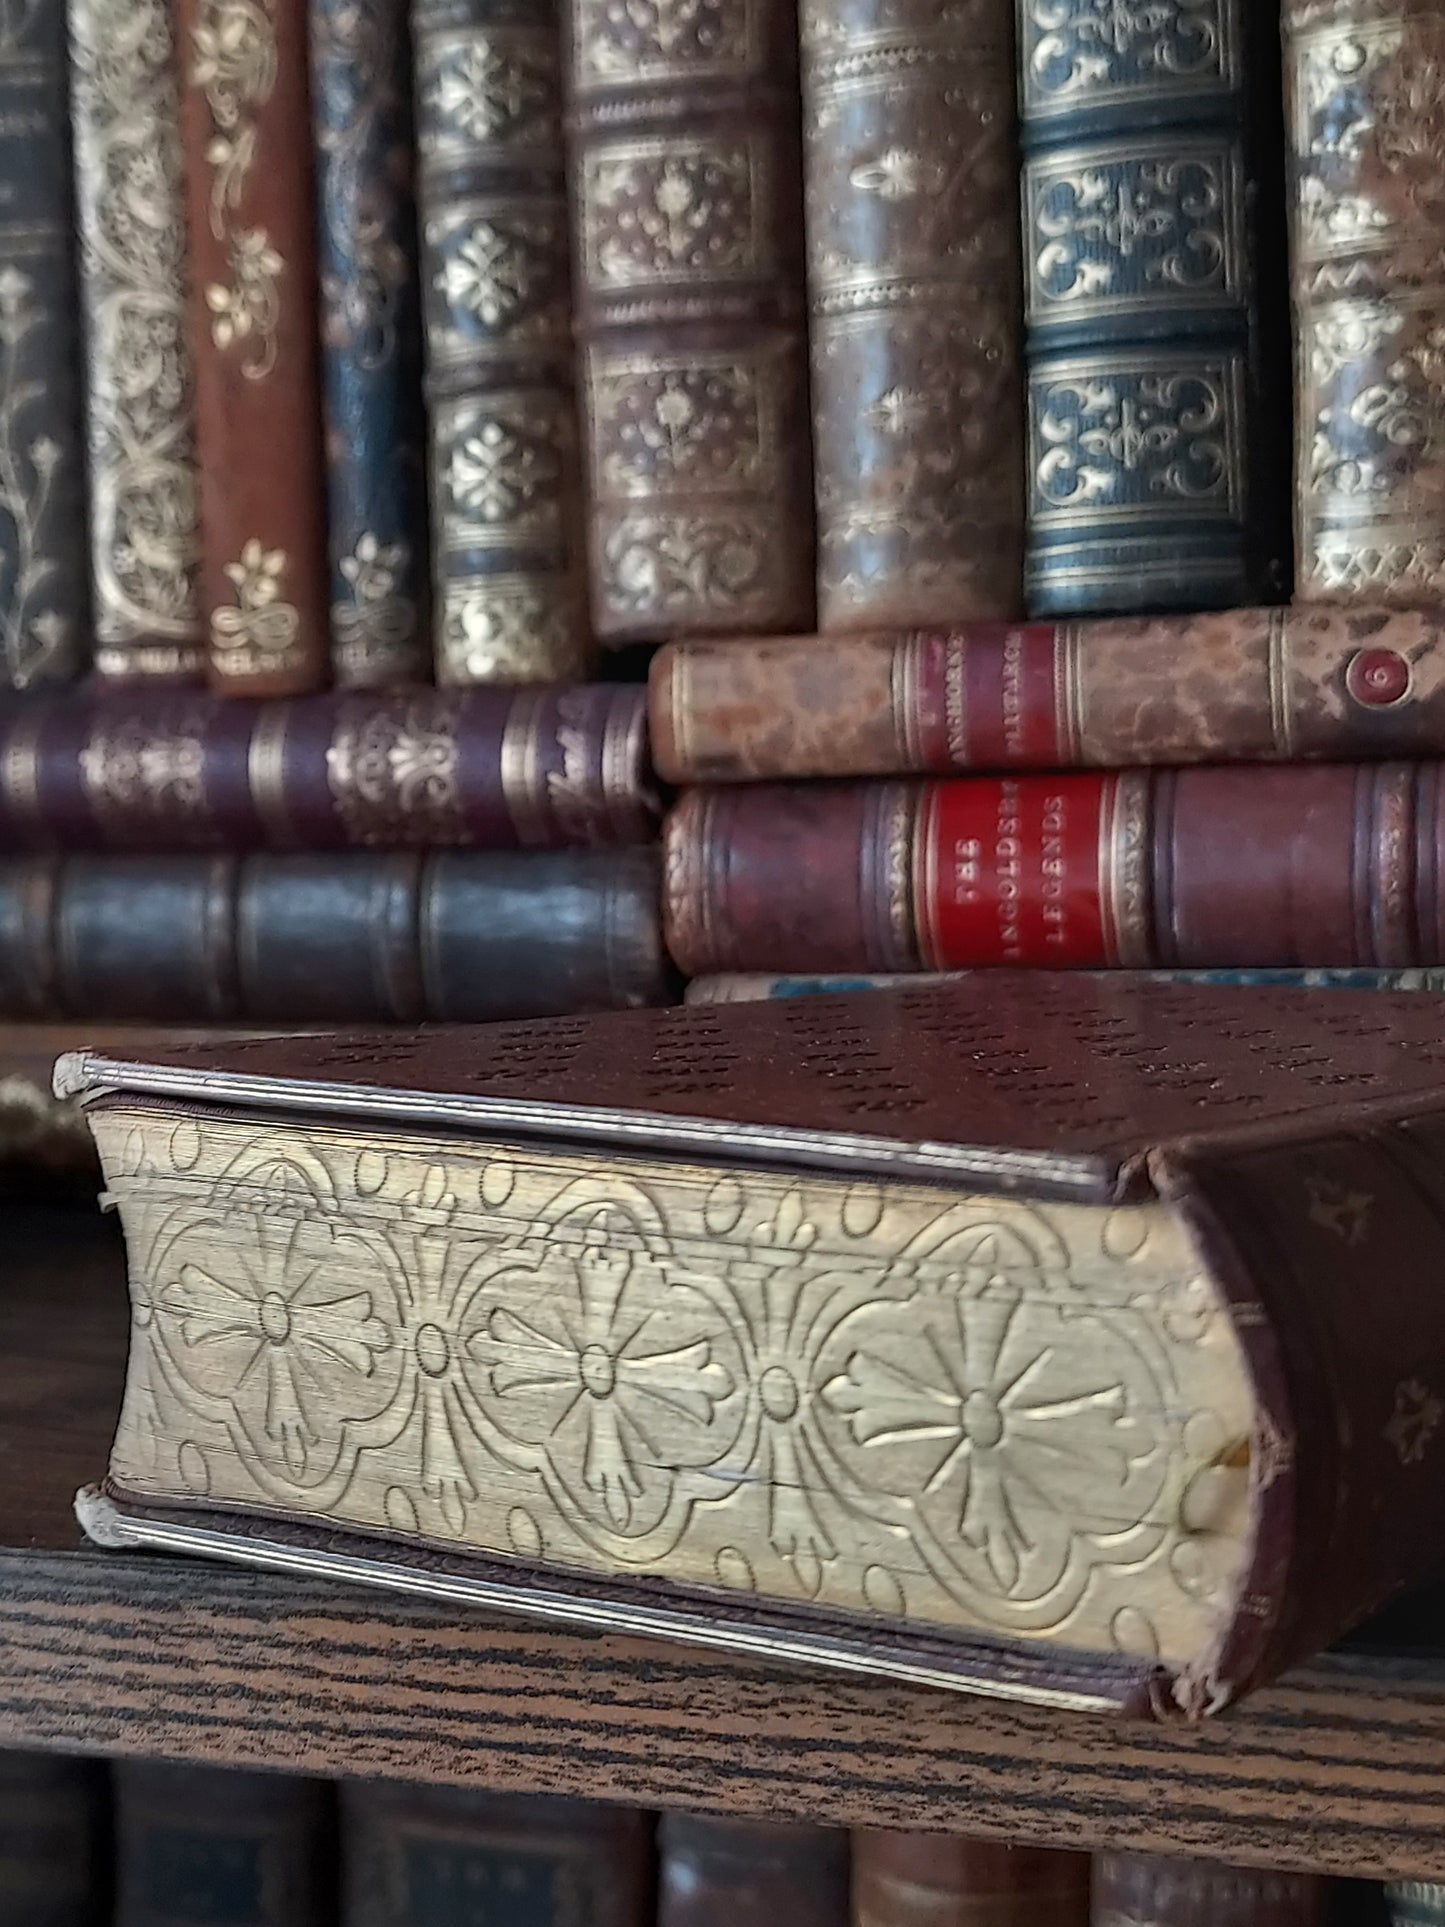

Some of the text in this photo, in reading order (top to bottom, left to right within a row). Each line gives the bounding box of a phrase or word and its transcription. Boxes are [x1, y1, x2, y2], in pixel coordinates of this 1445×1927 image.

[955, 838, 980, 904] THE
[996, 780, 1020, 958] INGOLDSBY
[1041, 796, 1064, 943] LEGENDS
